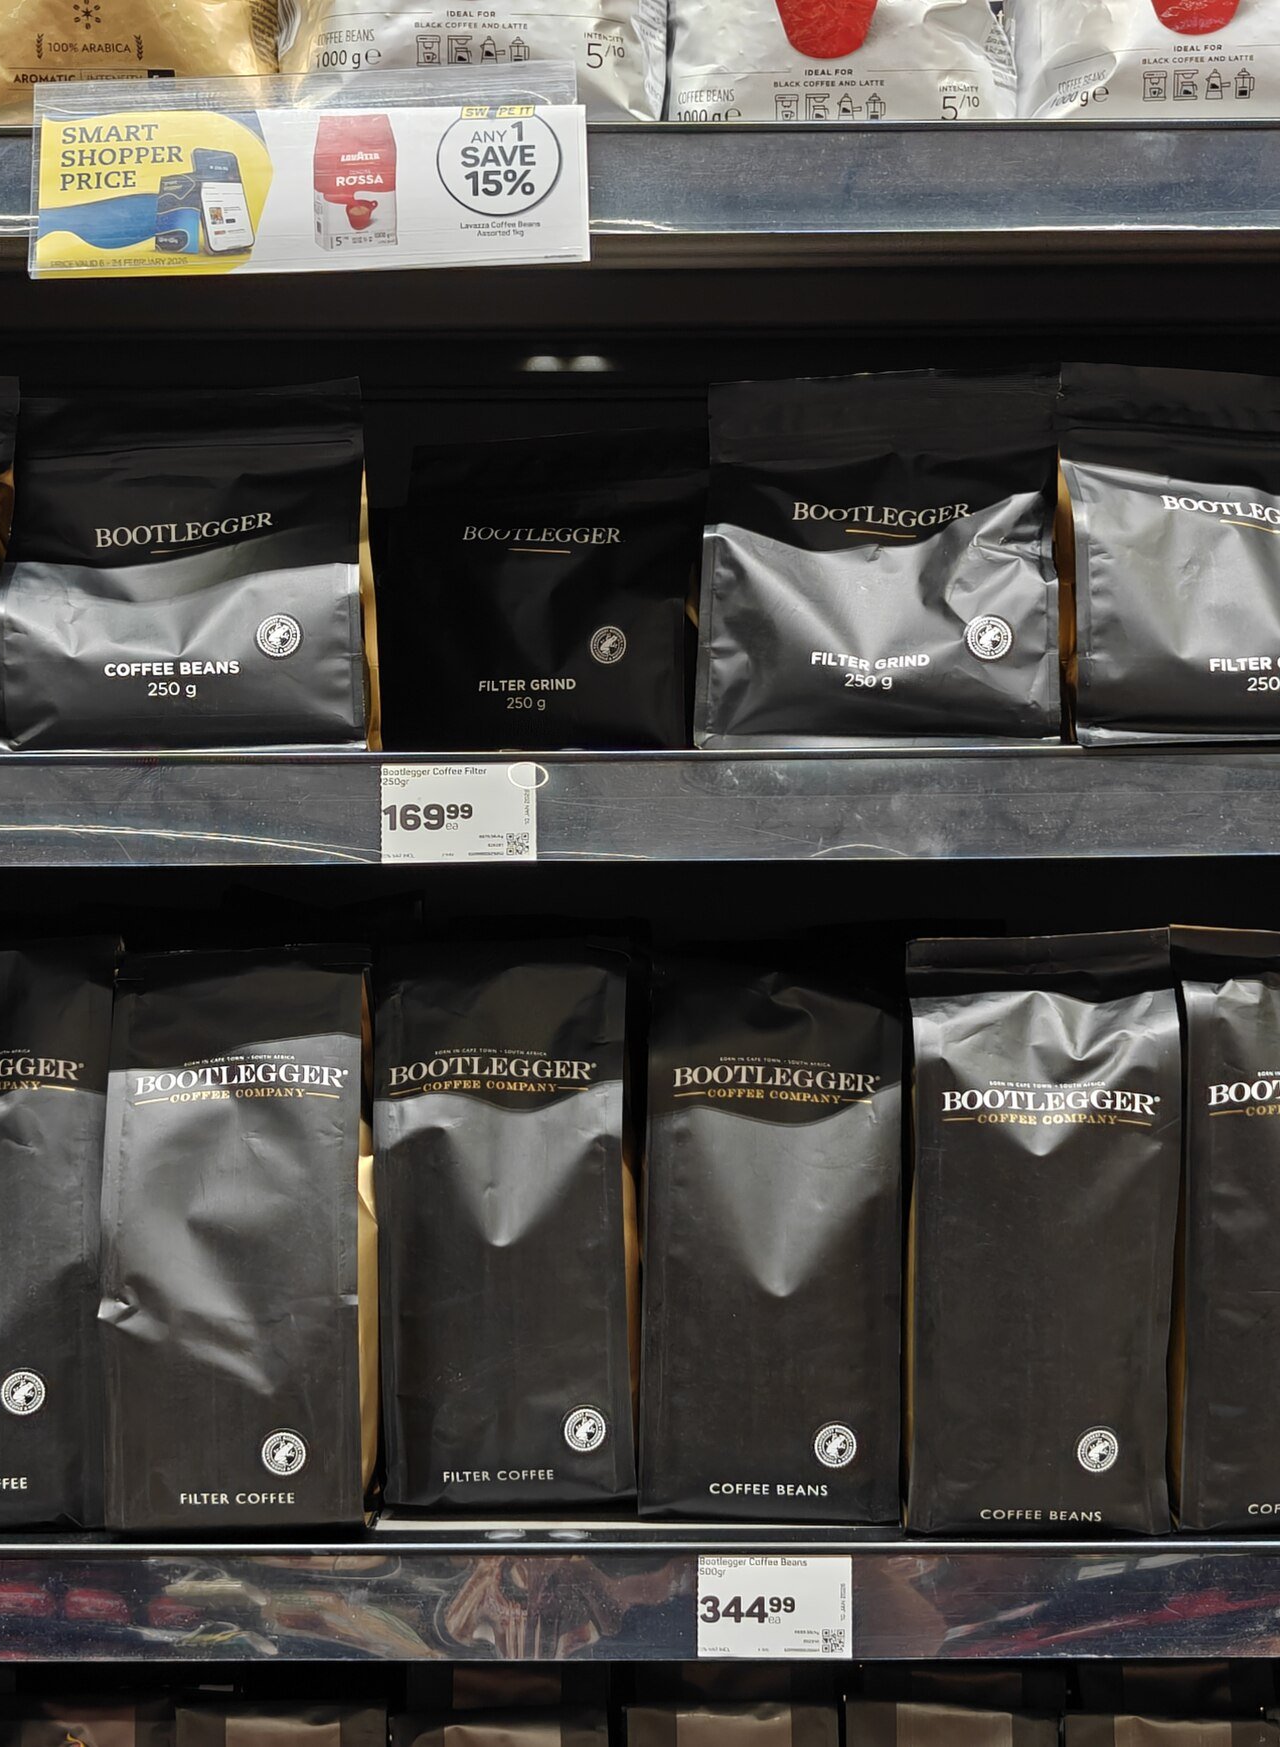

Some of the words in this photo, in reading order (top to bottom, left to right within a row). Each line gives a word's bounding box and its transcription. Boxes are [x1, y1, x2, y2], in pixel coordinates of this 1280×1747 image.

[62, 124, 158, 144] SMART
[471, 131, 507, 144] ANY
[511, 122, 523, 142] 1
[61, 146, 183, 168] SHOPPER
[461, 145, 535, 168] SAVE
[60, 171, 136, 191] PRICE
[336, 174, 384, 187] ROSSA
[465, 170, 535, 196] 15%
[460, 221, 489, 229] Lavazza
[104, 661, 174, 677] COFFEE
[179, 660, 240, 676] BEANS
[811, 652, 870, 669] FILTER
[875, 653, 930, 669] GRIND
[1209, 656, 1274, 674] FILTER
[147, 682, 180, 697] 250
[184, 684, 197, 700] g
[478, 678, 527, 692] FILTER
[532, 677, 577, 691] GRIND
[382, 766, 429, 779] Bootlegger
[432, 766, 461, 777] Coffee
[463, 766, 488, 776] Filter
[169, 1090, 230, 1104] COFFEE
[236, 1088, 305, 1098] COMPANY
[179, 1491, 231, 1505] FILTER
[236, 1490, 296, 1506] COFFEE
[709, 1482, 769, 1496] COFFEE
[775, 1482, 828, 1497] BEANS
